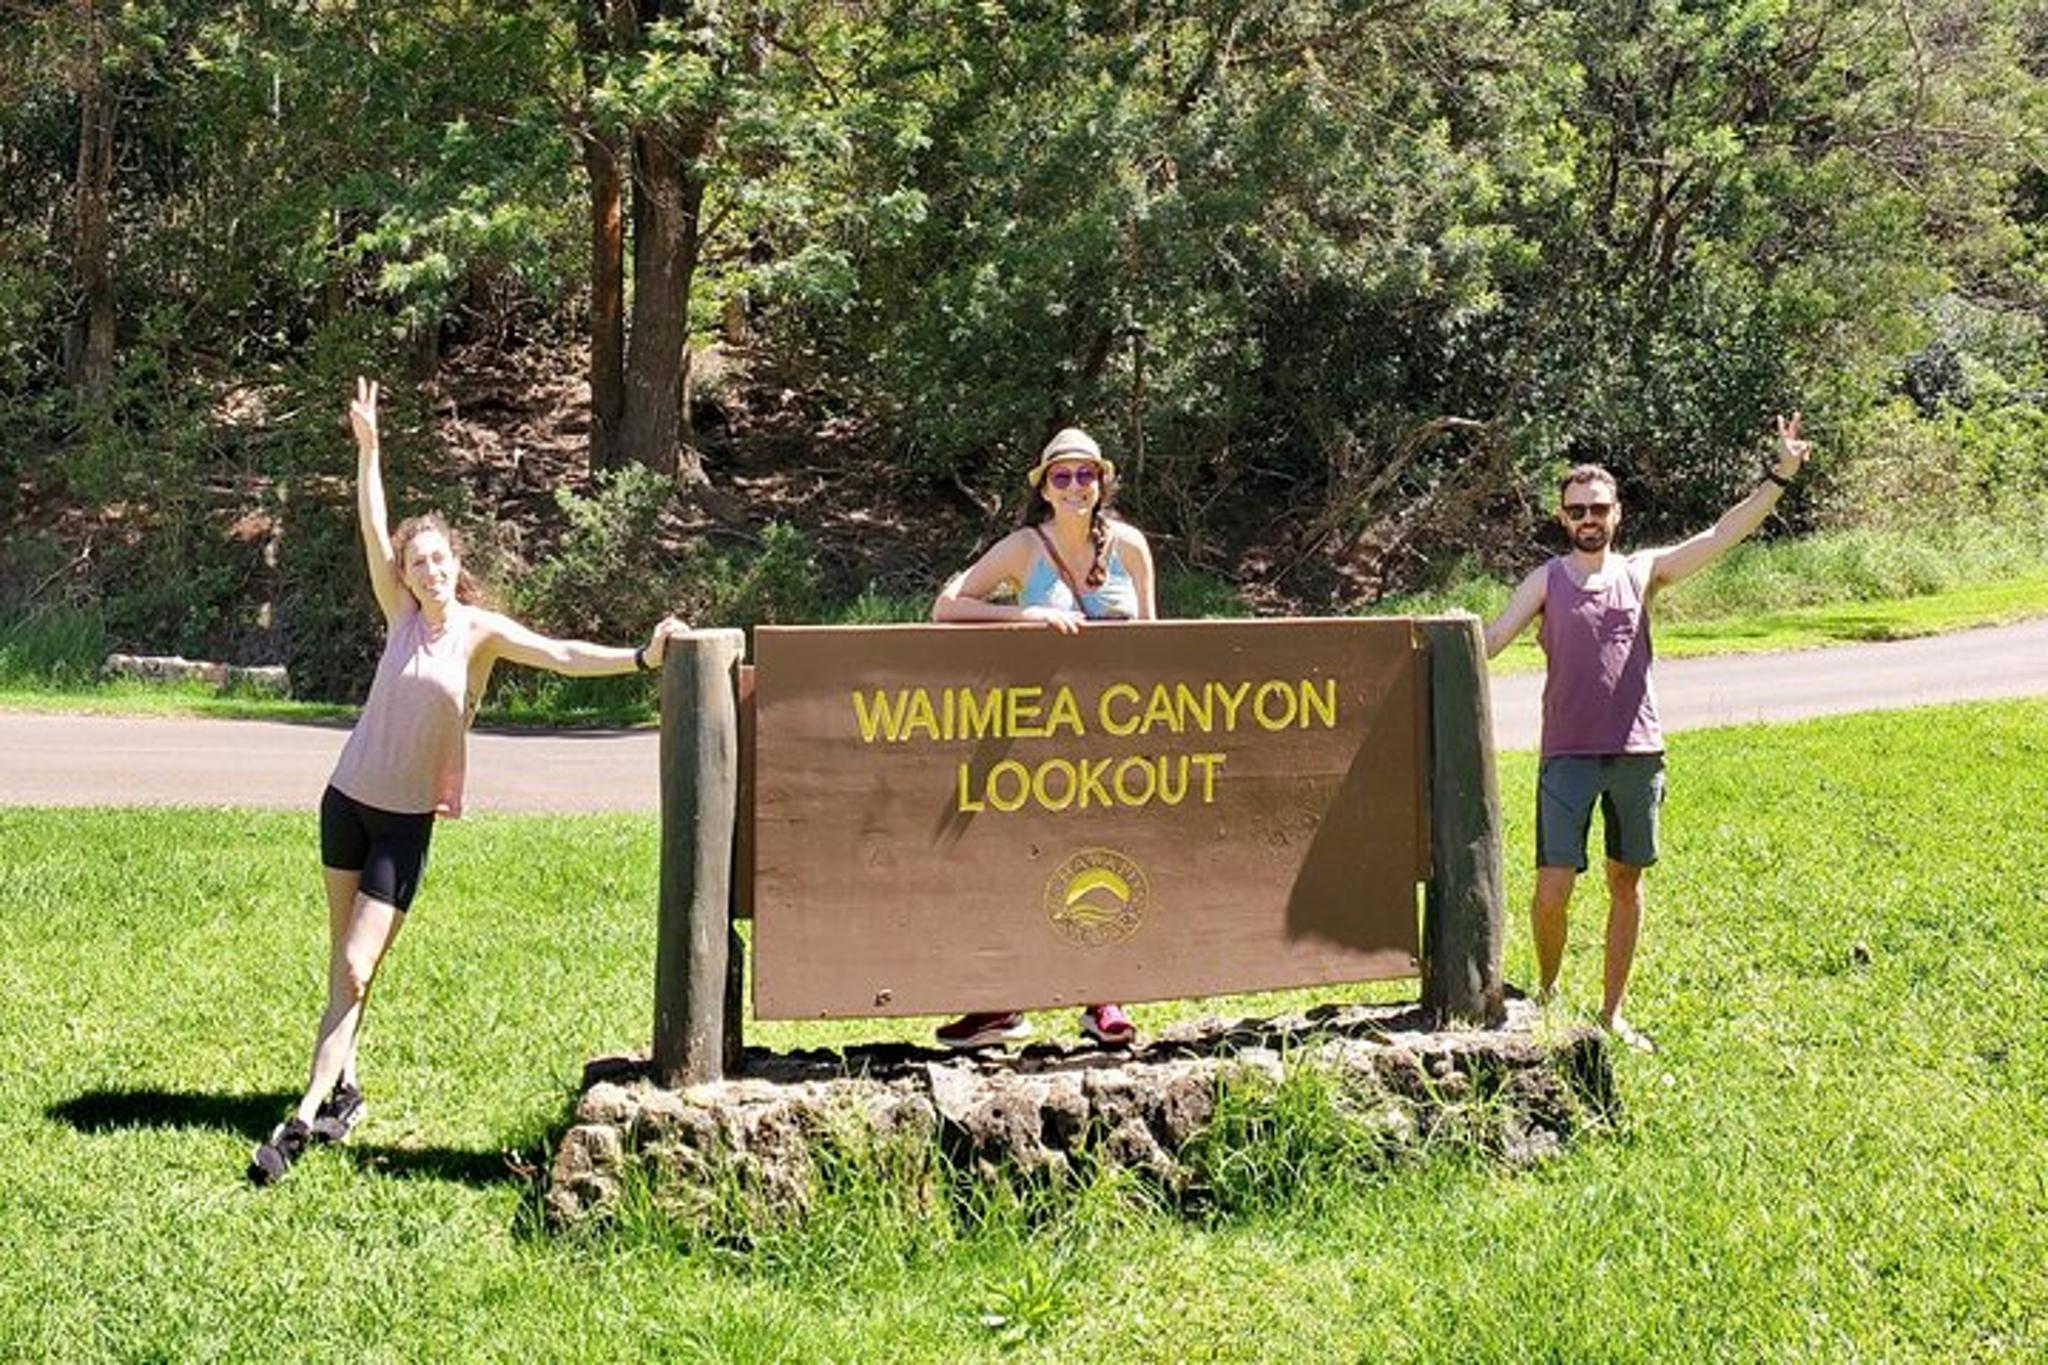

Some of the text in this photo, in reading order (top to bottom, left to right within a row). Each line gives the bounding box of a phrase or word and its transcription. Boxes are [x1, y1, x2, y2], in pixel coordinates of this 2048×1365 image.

[851, 679, 1339, 743] WAIMEA CANYON
[957, 752, 1227, 813] LOOKOUT
